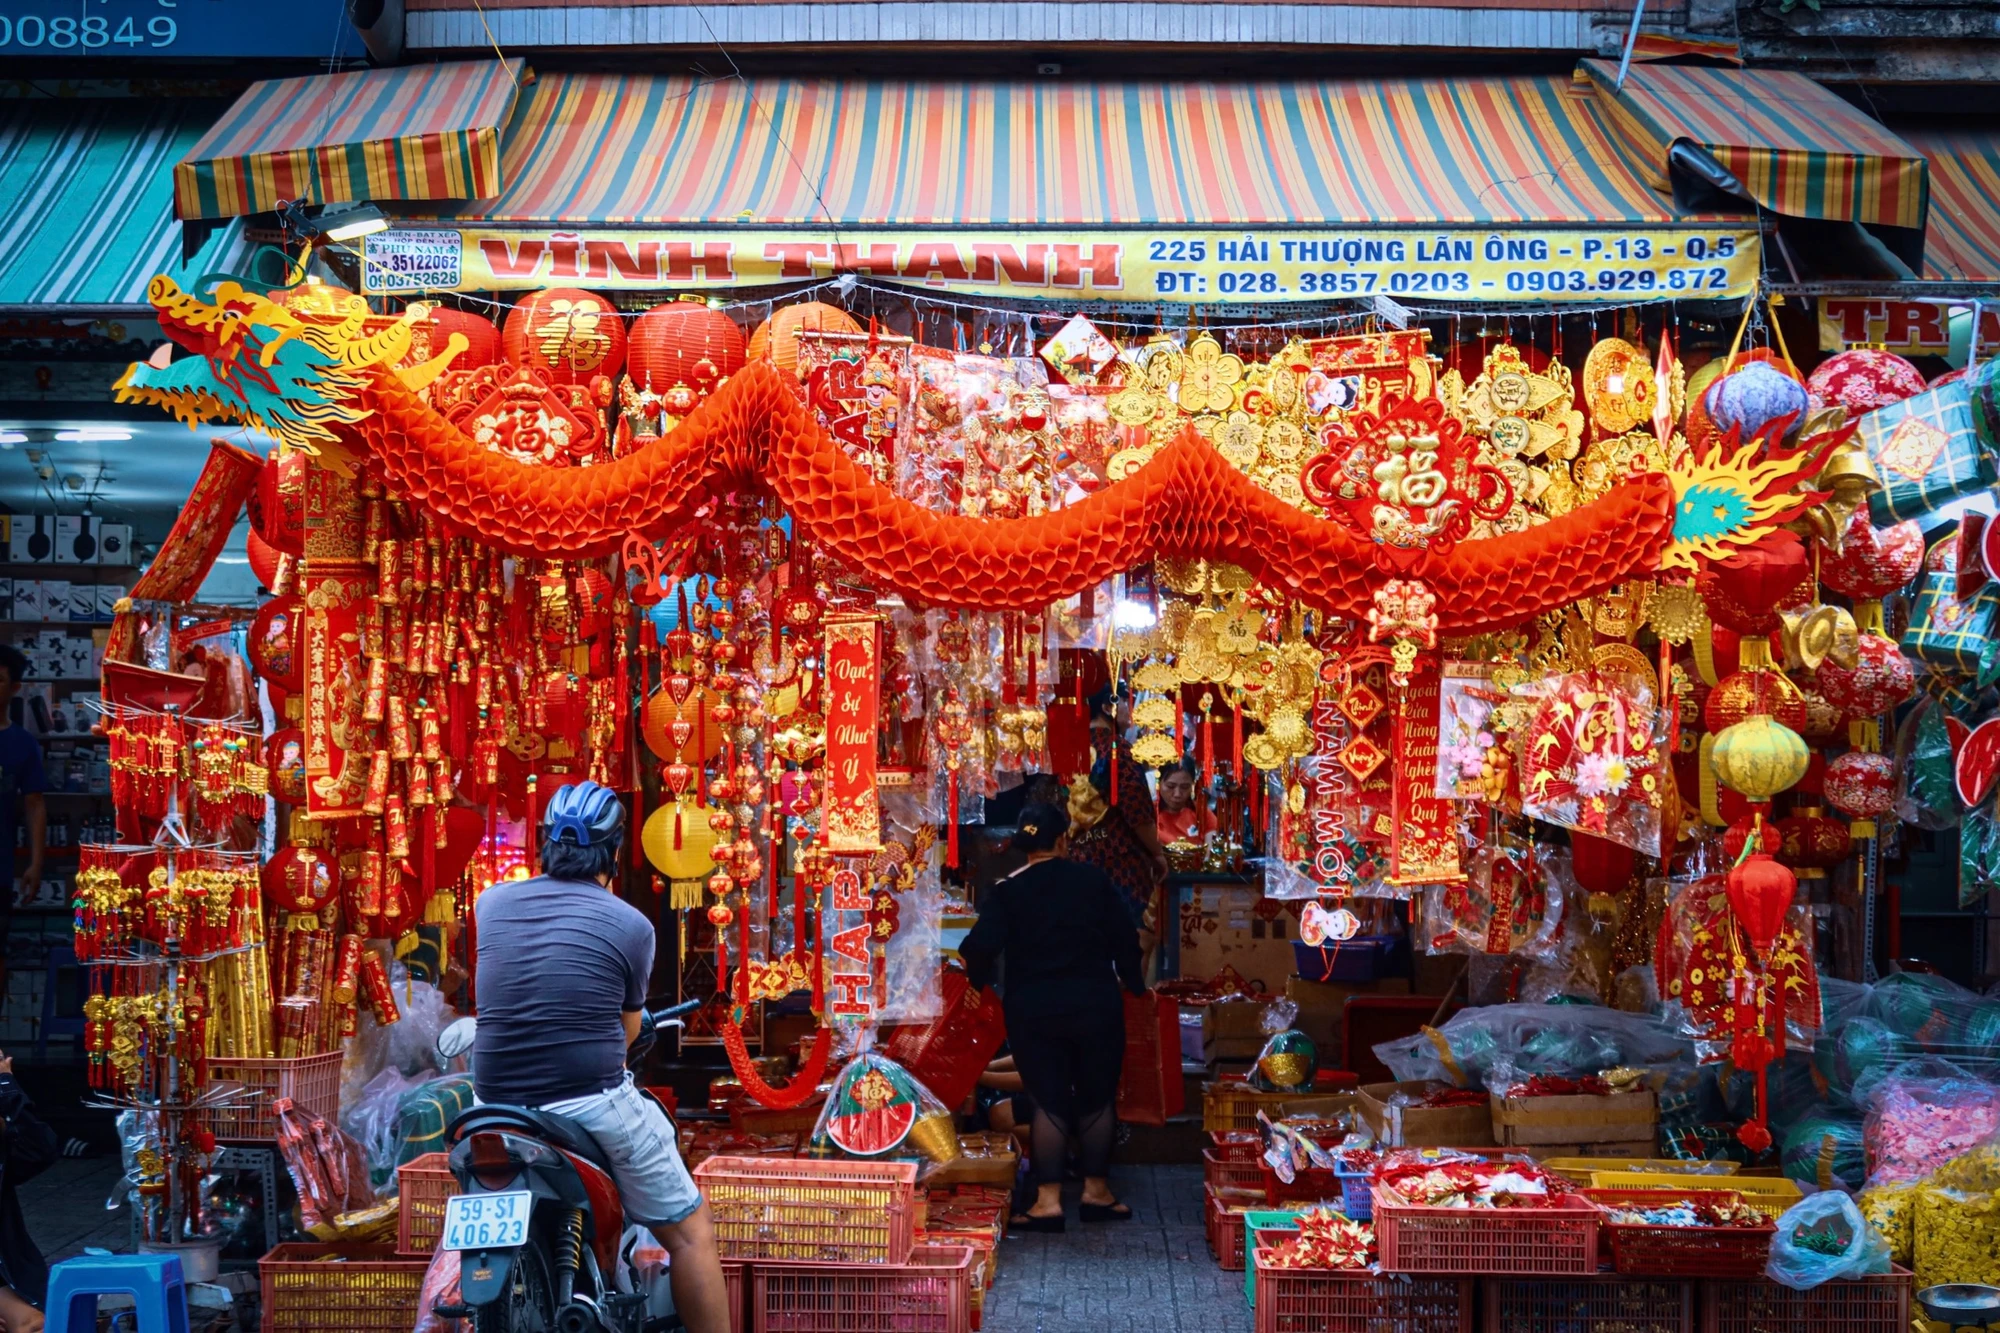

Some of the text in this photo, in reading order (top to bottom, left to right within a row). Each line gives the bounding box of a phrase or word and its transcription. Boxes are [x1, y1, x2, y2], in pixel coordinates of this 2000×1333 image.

[414, 245, 444, 256] NAM
[479, 231, 736, 281] VĨNH
[1149, 240, 1206, 262] 225
[1217, 234, 1269, 262] HẢI
[1280, 238, 1405, 267] THƯỢNG
[1417, 235, 1473, 262] LÃN
[1484, 235, 1548, 262] ÔNG
[1583, 238, 1652, 260] P.13
[1686, 237, 1736, 261] Q.5
[1155, 271, 1207, 294] ĐT:
[1218, 271, 1288, 294] 028.
[1299, 271, 1470, 293] 3857.0203
[1506, 267, 1728, 292] 0903.929.872
[535, 299, 612, 372] 福
[495, 401, 548, 452] 福
[1373, 433, 1448, 508] 福
[834, 658, 868, 684] Vạn
[835, 724, 869, 746] Như
[842, 753, 860, 785] Ý
[875, 897, 893, 938] 平安
[832, 870, 873, 1016] HAP
[450, 1220, 523, 1246] 406.23
